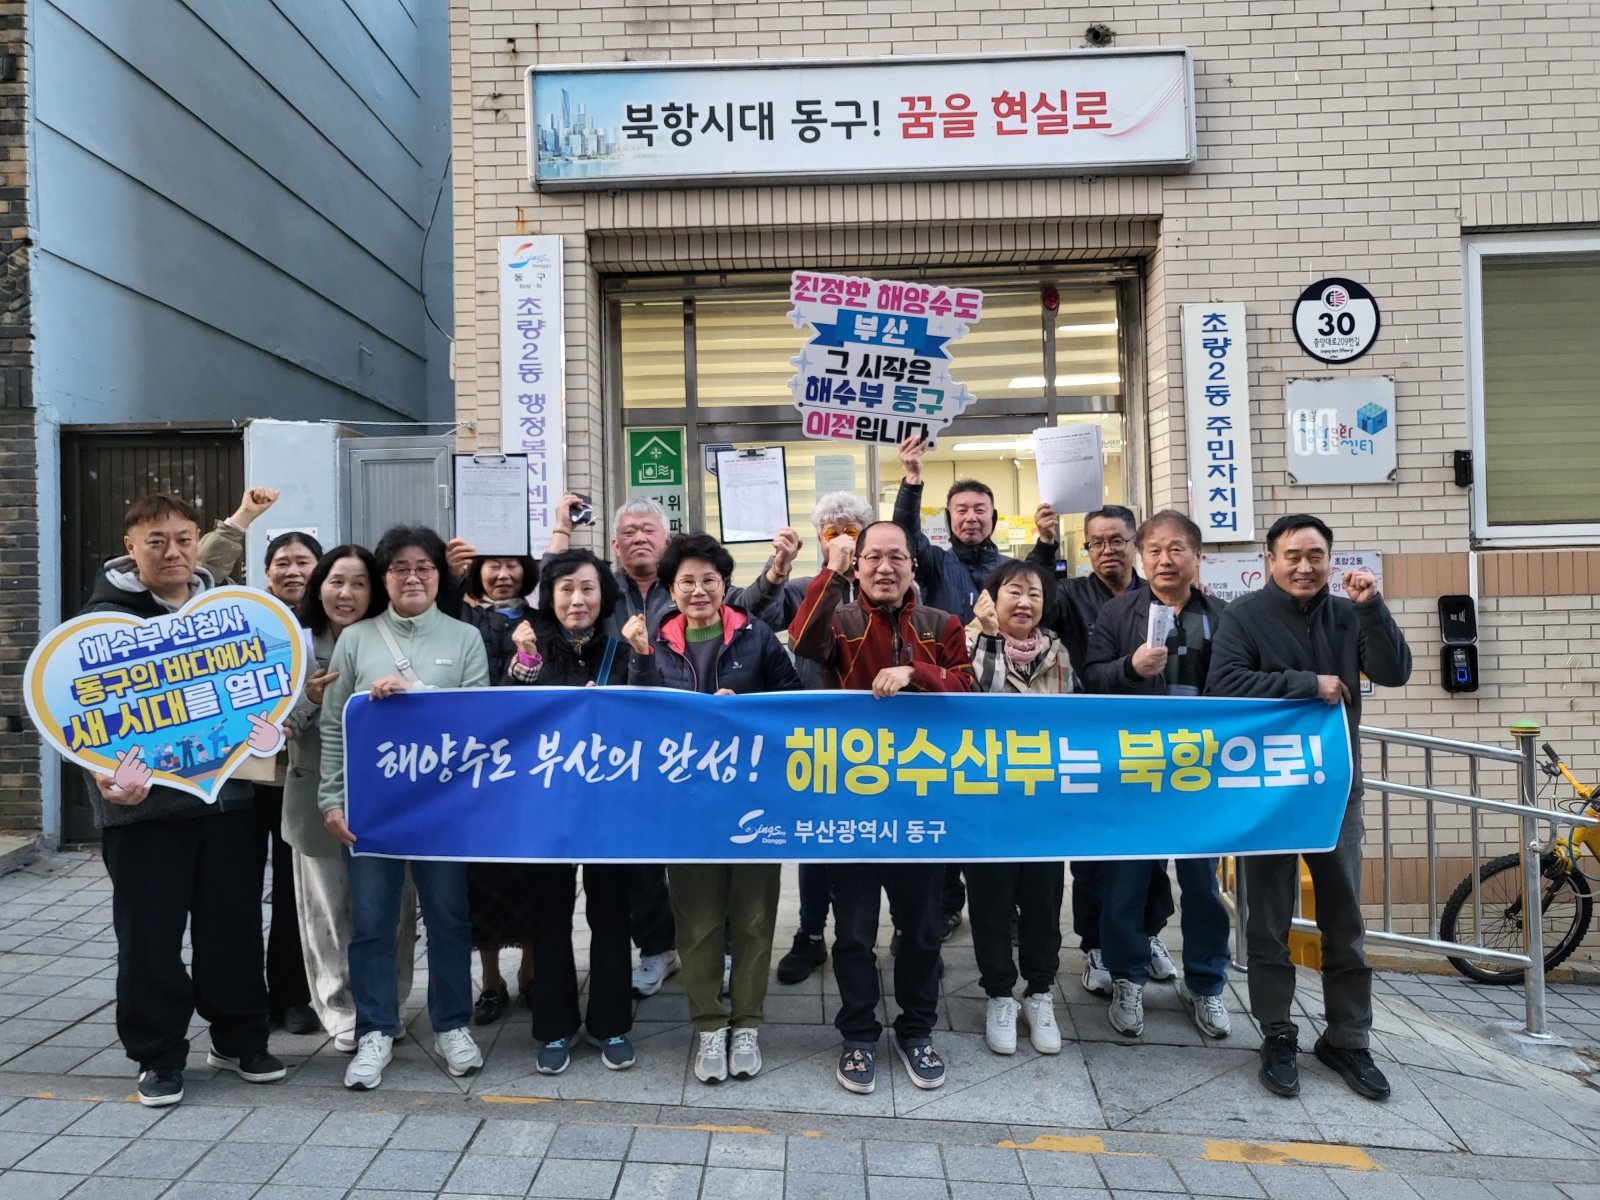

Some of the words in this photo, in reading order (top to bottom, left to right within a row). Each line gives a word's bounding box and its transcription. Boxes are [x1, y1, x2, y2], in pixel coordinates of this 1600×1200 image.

[622, 101, 774, 147] 북항시대
[791, 99, 882, 144] 동구!
[897, 92, 978, 140] 꿈을
[991, 89, 1112, 136] 현실로
[794, 275, 870, 308] 진정한
[877, 284, 980, 320] 해양수도
[1317, 312, 1356, 337] 30
[517, 296, 547, 384] 초량2동
[853, 314, 909, 345] 부산
[825, 349, 850, 376] 그
[856, 354, 932, 385] 시작은
[1201, 312, 1232, 407] 초량2동
[805, 376, 884, 408] 해수부
[892, 385, 945, 415] 동구
[1205, 415, 1238, 532] 주민자치회
[78, 623, 164, 666] 해수부
[168, 605, 247, 642] 신청사
[73, 661, 162, 706] 동구의
[162, 636, 266, 685] 바다에서
[68, 708, 109, 751] 새
[117, 679, 222, 739] 시대를
[224, 662, 292, 710] 열다
[376, 732, 517, 789] 해양수도
[528, 730, 643, 789] 부산의
[657, 732, 764, 784] 완성!
[785, 727, 1101, 796] 해양수산부는
[1117, 728, 1326, 793] 북항으로!
[794, 819, 898, 844] 부산광역시
[905, 820, 947, 844] 동구
